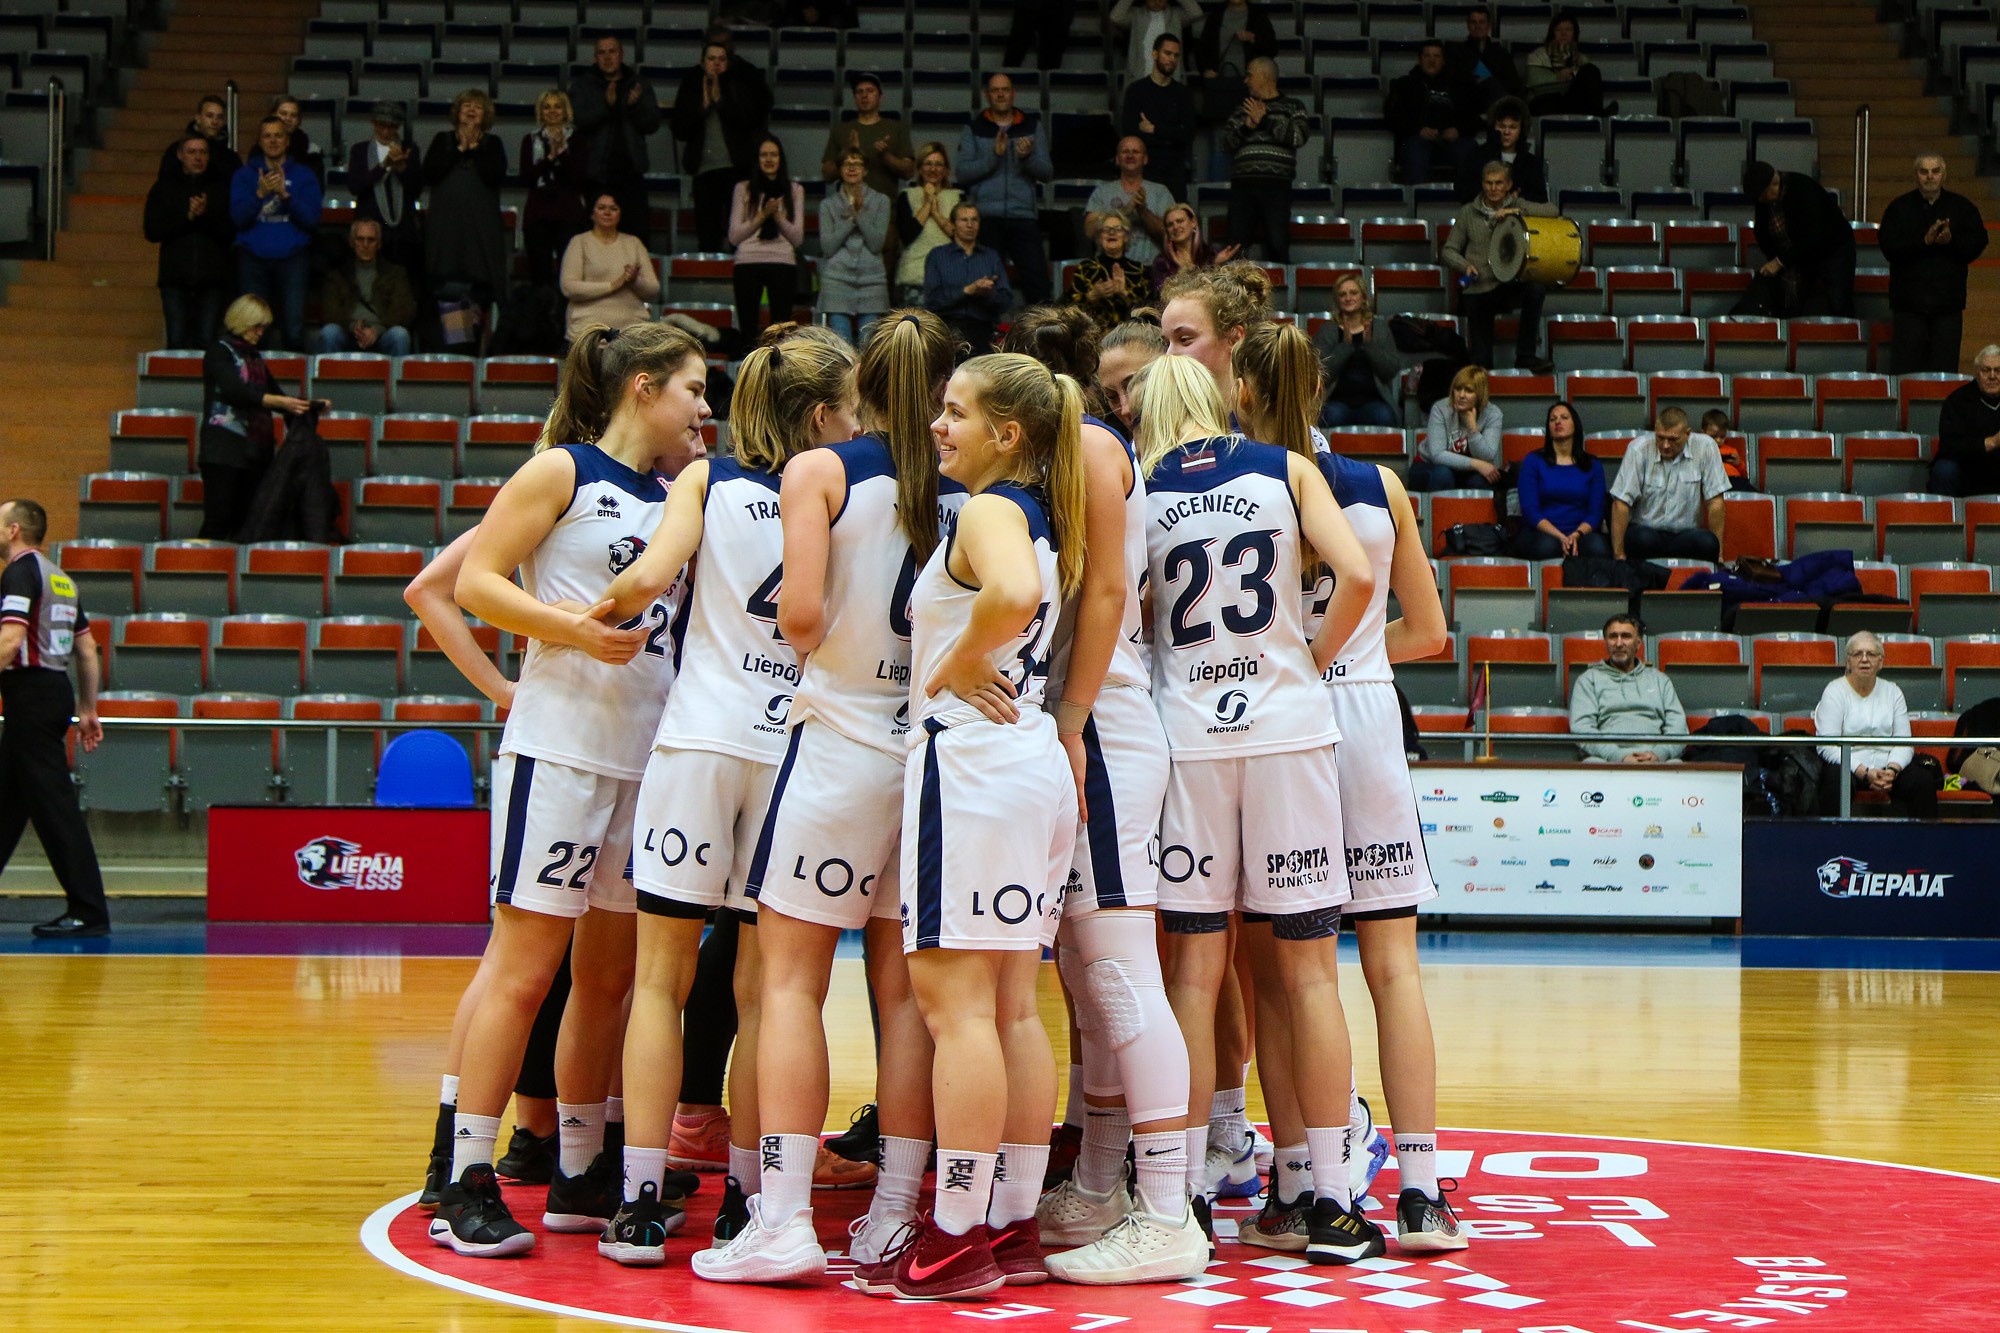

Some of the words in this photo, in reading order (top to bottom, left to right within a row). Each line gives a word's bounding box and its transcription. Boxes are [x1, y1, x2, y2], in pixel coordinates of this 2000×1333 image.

[597, 508, 621, 519] errea
[1158, 494, 1260, 532] LOCENIECE
[1164, 528, 1284, 651] 23
[876, 659, 912, 686] Liep
[1189, 657, 1258, 684] Liepāja
[1206, 723, 1250, 734] ekovalis
[644, 828, 712, 868] LOC
[331, 853, 404, 874] LIEPĀJA
[536, 841, 601, 893] 22
[793, 855, 875, 898] LOC
[1159, 844, 1214, 883] OC
[355, 873, 404, 891] LSSS
[1268, 870, 1330, 889] PUNKTS.LV
[1847, 868, 1954, 897] LIEPĀJA
[763, 1136, 783, 1173] PEAK
[1399, 1142, 1434, 1152] errea
[945, 1157, 977, 1192] PEAK
